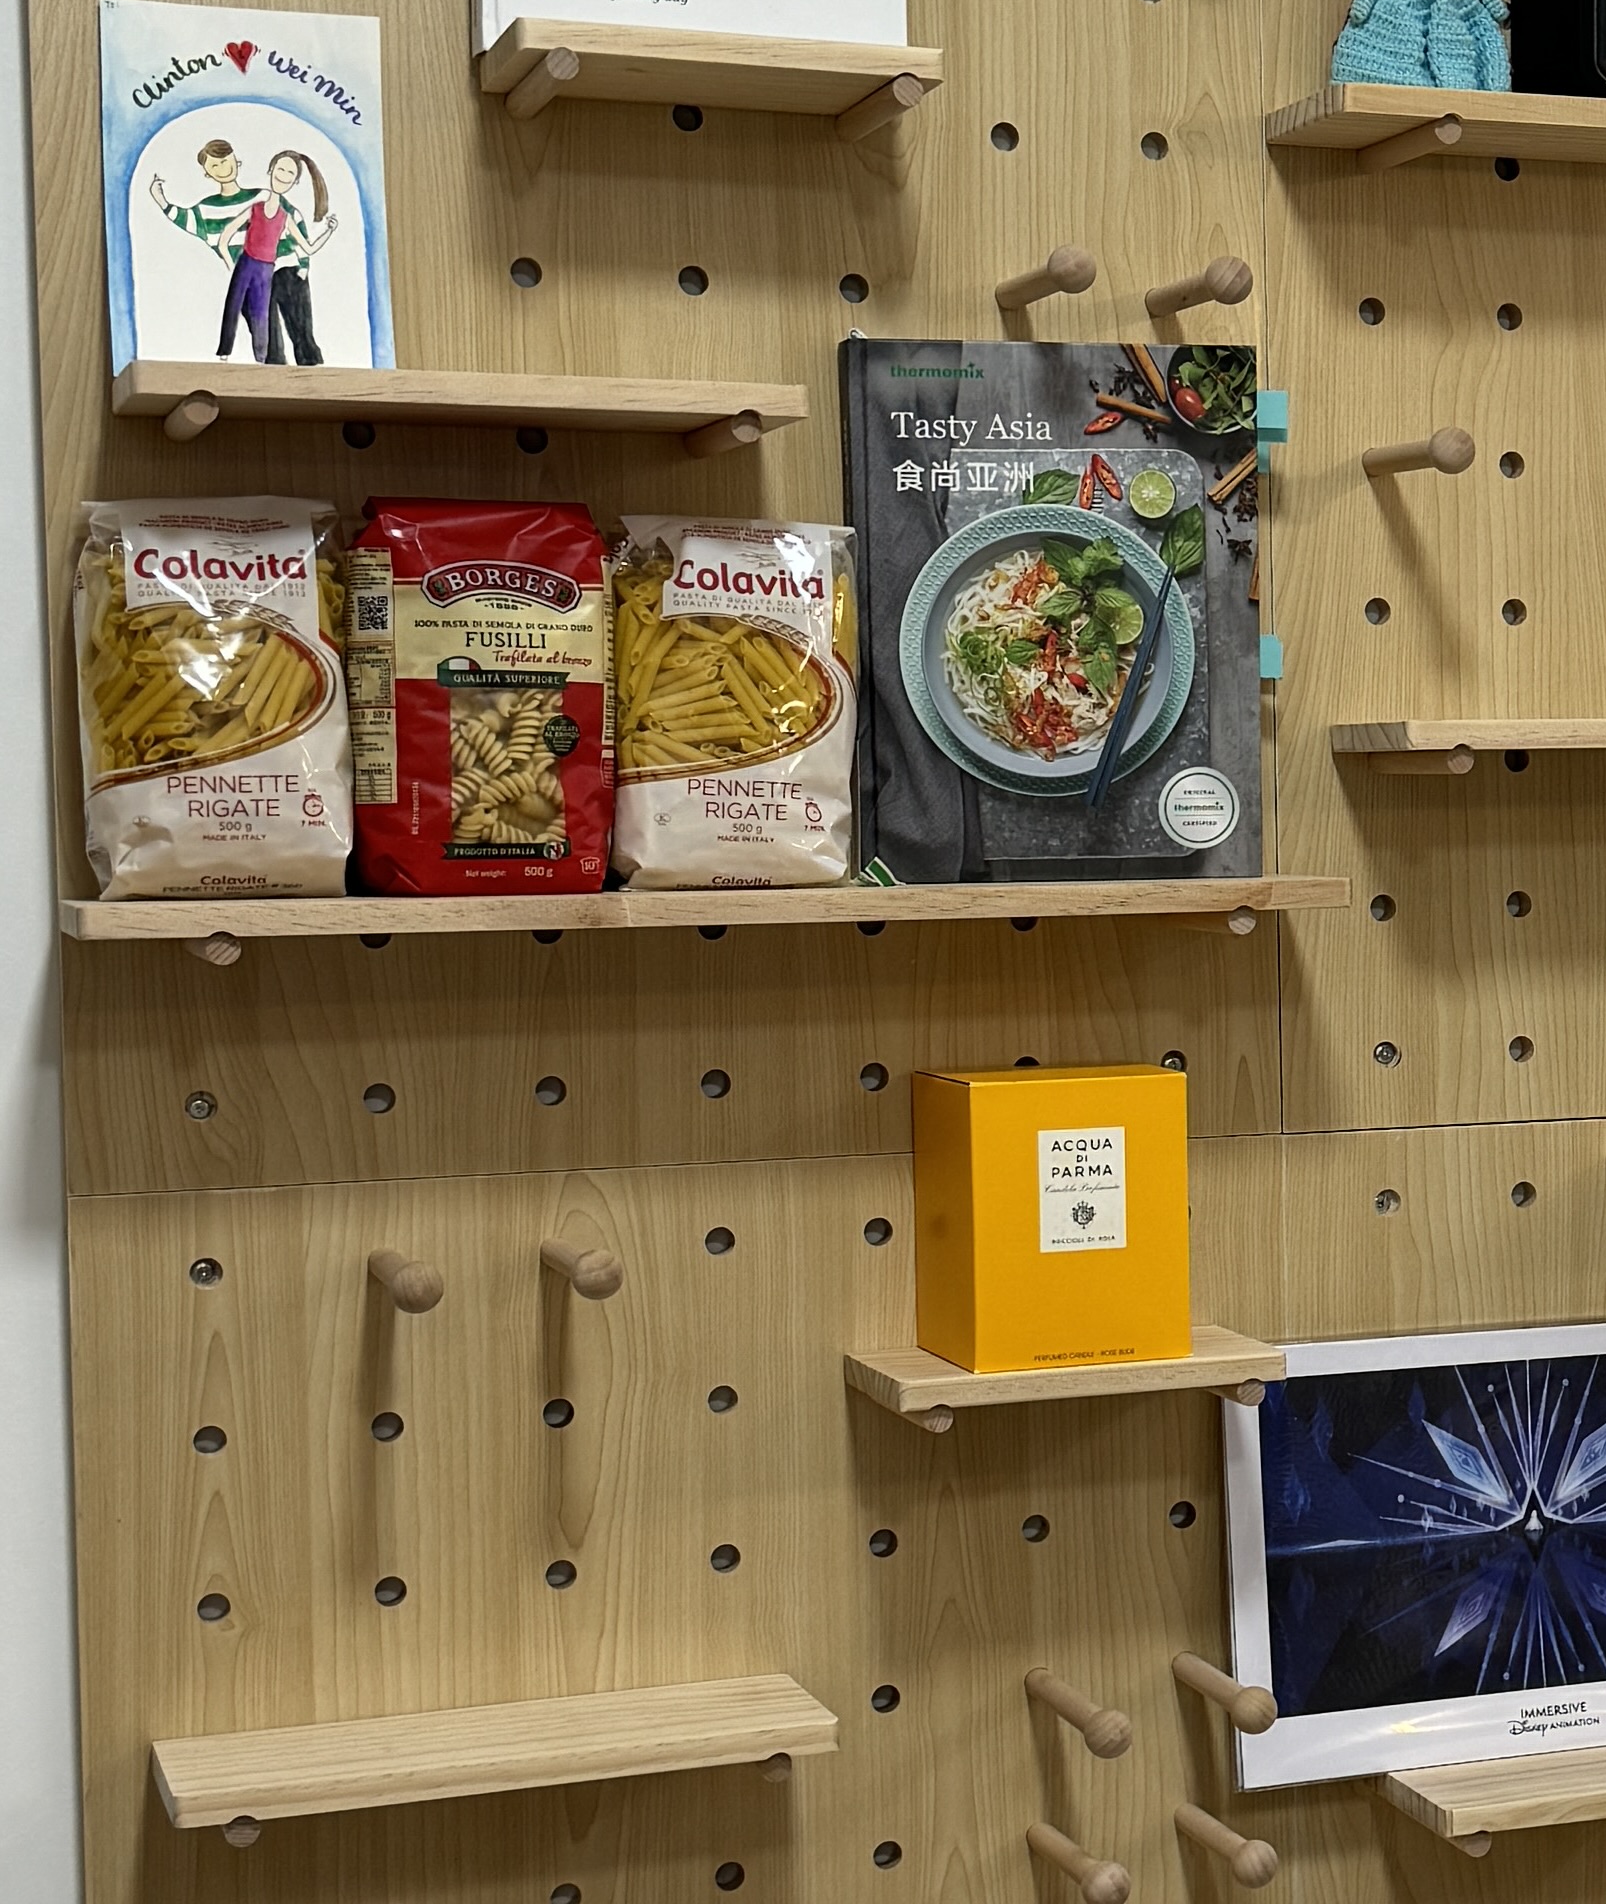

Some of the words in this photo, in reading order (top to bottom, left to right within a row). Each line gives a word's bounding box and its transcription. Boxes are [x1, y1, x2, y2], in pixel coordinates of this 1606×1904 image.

[132, 52, 222, 108] Clinton
[889, 362, 985, 380] thermomix
[890, 411, 979, 446] Tasty
[985, 413, 1053, 442] Asia
[892, 458, 1035, 494] 食尚亚洲
[133, 547, 307, 582] Colavita
[445, 568, 558, 598] BORGES
[673, 559, 825, 600] Colavita
[673, 592, 709, 600] PASTA
[673, 599, 720, 608] QUALITY
[414, 619, 439, 628] 100%
[442, 620, 469, 628] PASTA
[473, 620, 483, 628] DI
[485, 621, 522, 629] SEMOLA
[526, 622, 535, 630] DI
[465, 631, 547, 649] FUSILLI
[504, 674, 561, 685] SUPERIORE
[167, 775, 300, 794] PENNETTE
[687, 778, 803, 800] PENNETTE
[188, 798, 281, 818] RIGATE
[705, 801, 788, 821] RIGATE
[219, 821, 241, 831] 500
[245, 823, 253, 833] g
[732, 823, 753, 833] 500
[756, 825, 763, 834] g
[203, 834, 228, 842] MADE
[717, 835, 740, 843] MADE
[454, 847, 498, 856] PRODOTTO
[524, 866, 545, 877] 500
[547, 868, 553, 878] g
[200, 875, 267, 886] Colavita
[712, 876, 773, 886] Colavita
[1052, 1138, 1113, 1152] ACQUA
[1076, 1154, 1088, 1163] DI
[1052, 1164, 1113, 1178] PARMA
[1520, 1701, 1587, 1719] IMMERSIVE
[1550, 1716, 1600, 1730] ANIMATION
